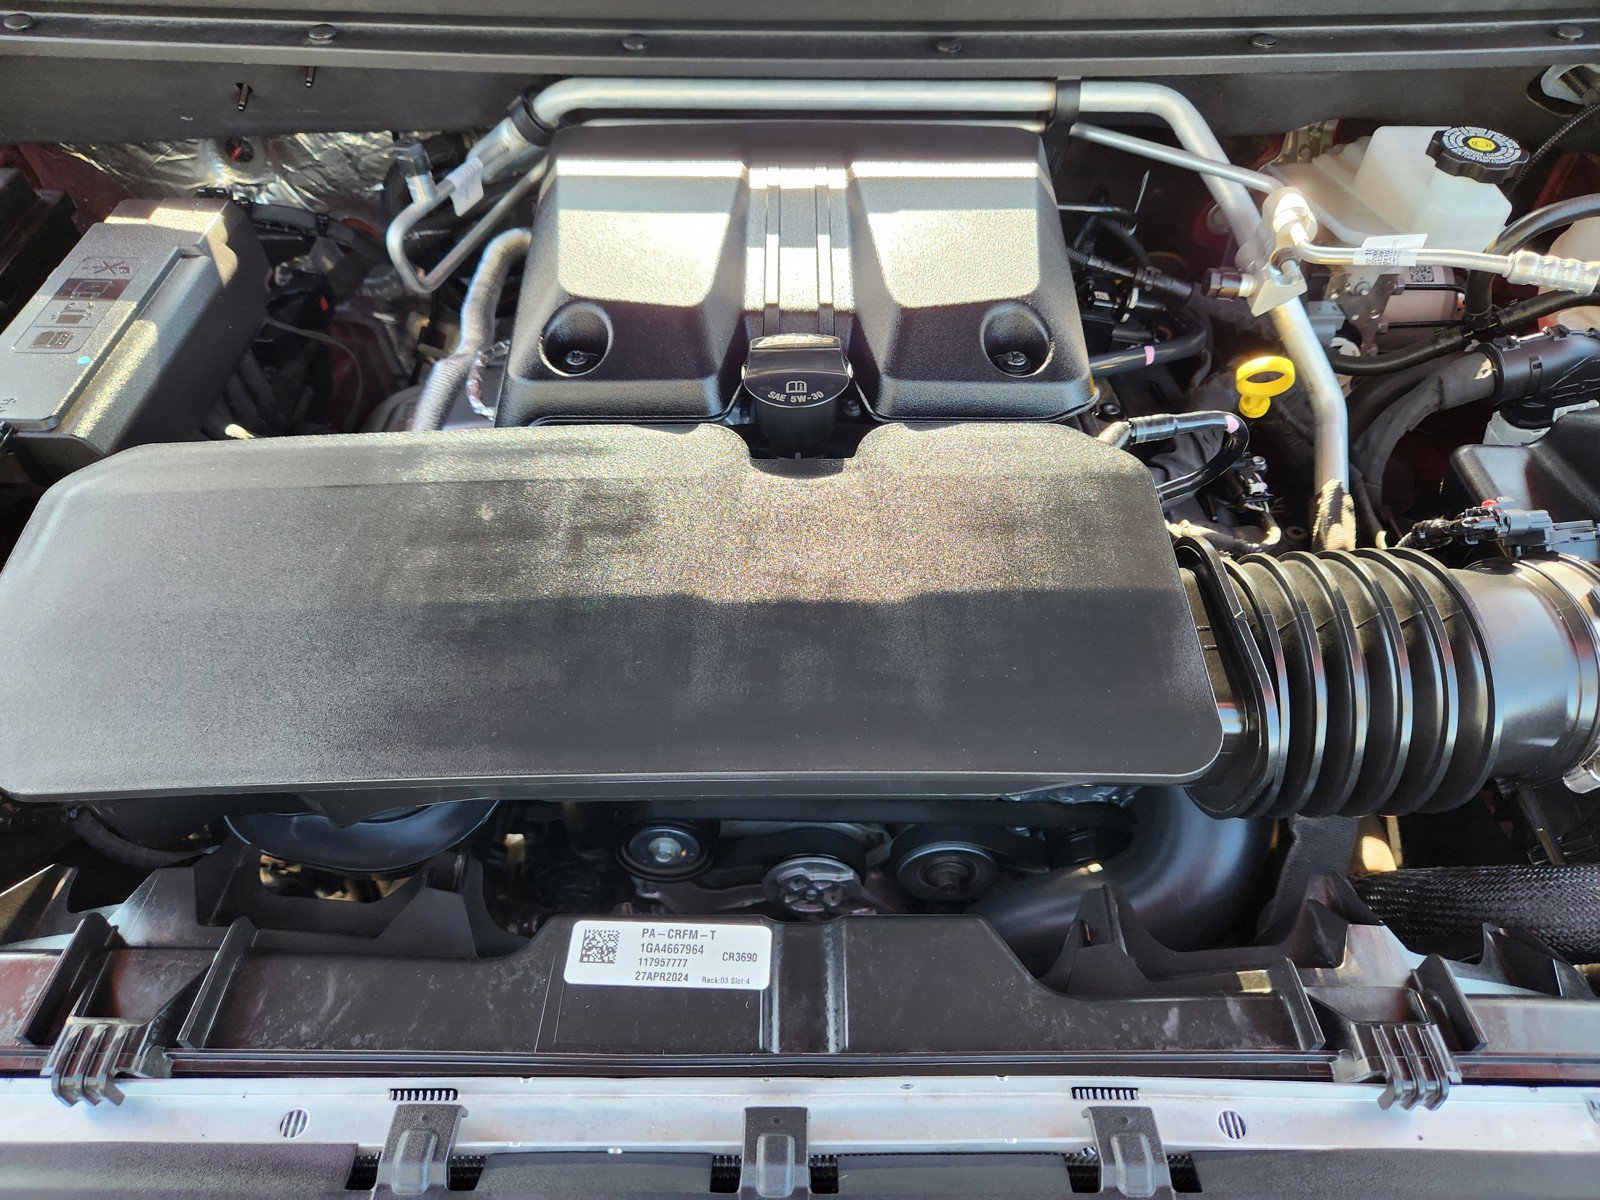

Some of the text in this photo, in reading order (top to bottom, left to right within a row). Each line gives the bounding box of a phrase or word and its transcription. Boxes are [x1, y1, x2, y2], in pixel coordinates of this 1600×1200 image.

[767, 391, 824, 403] SAE 5W-30
[640, 942, 704, 955] 1GA4667964
[638, 957, 688, 968] 117957777
[722, 952, 758, 963] CR3690
[635, 971, 689, 983] 27APR2024
